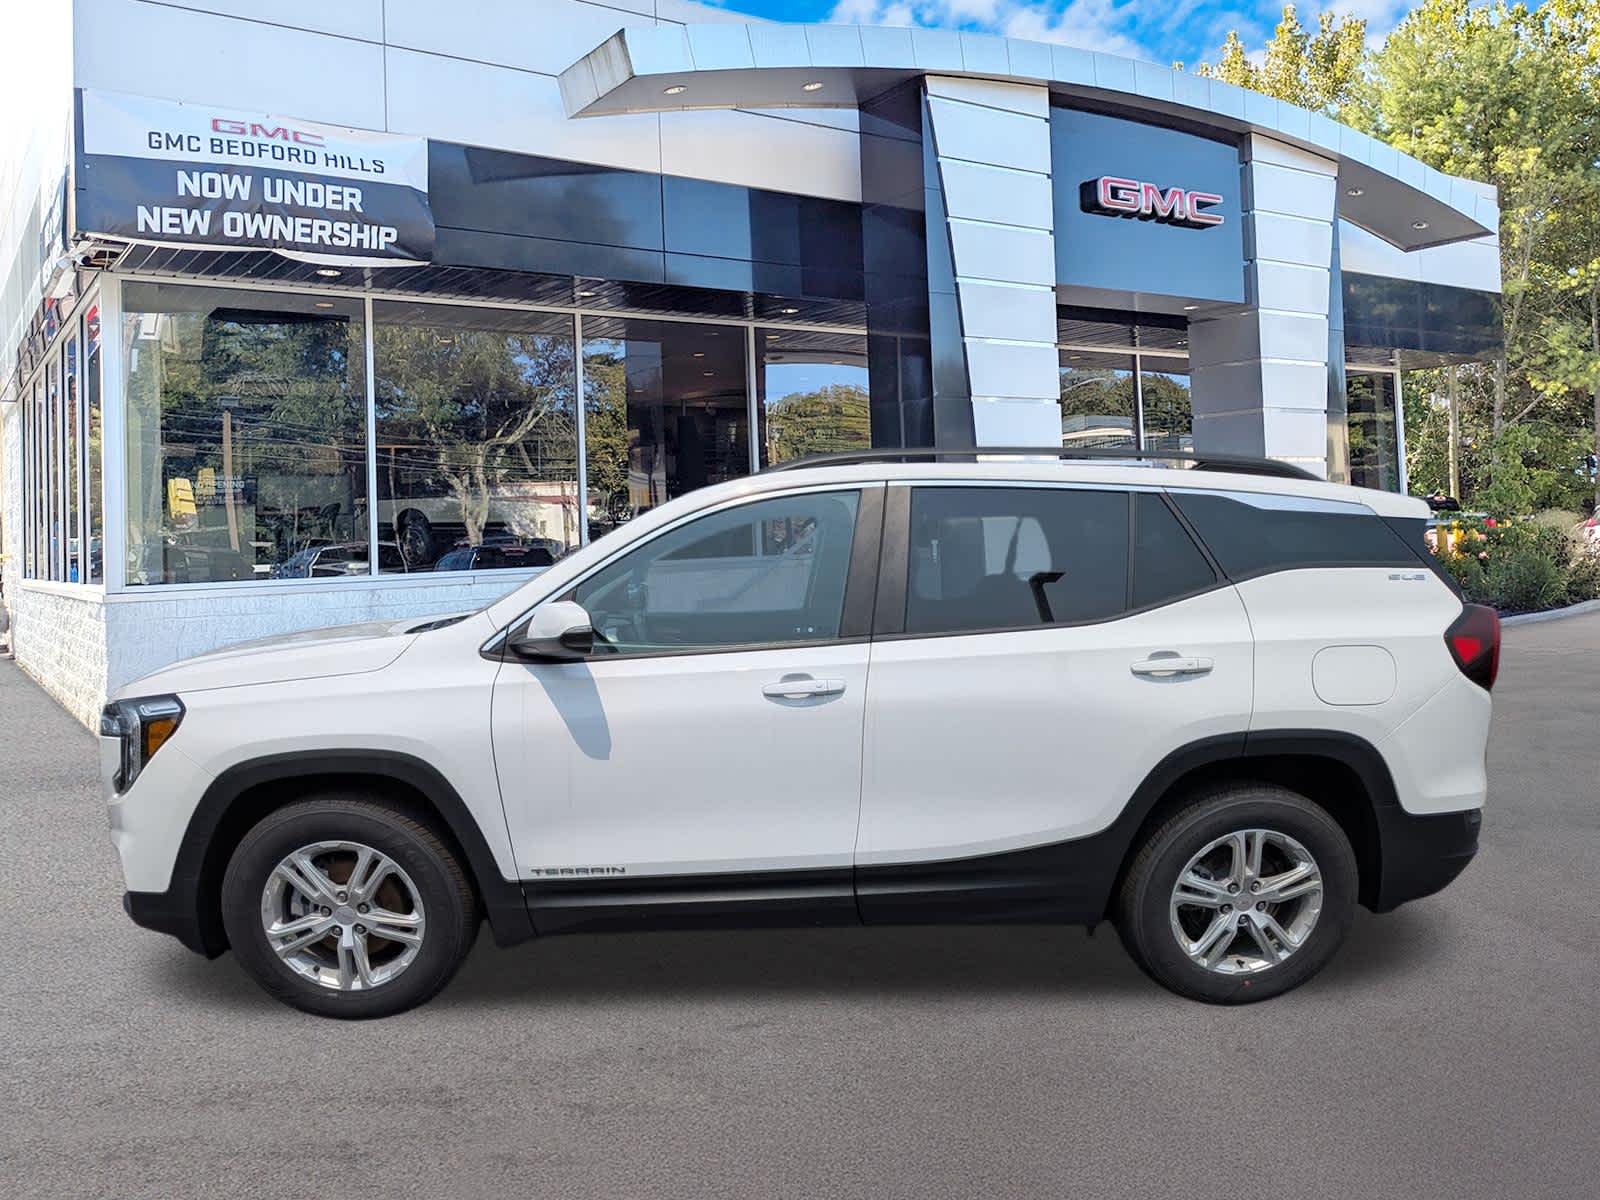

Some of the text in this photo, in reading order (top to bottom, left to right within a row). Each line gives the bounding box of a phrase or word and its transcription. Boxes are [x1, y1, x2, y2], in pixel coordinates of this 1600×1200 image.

[148, 131, 385, 174] GMC BEDFORD HILLS
[211, 119, 324, 147] GMC
[176, 170, 363, 212] NOW UNDER
[1097, 176, 1224, 225] GMC
[136, 205, 398, 250] NEW OWNERSHIP
[531, 866, 626, 876] TERRAIN
